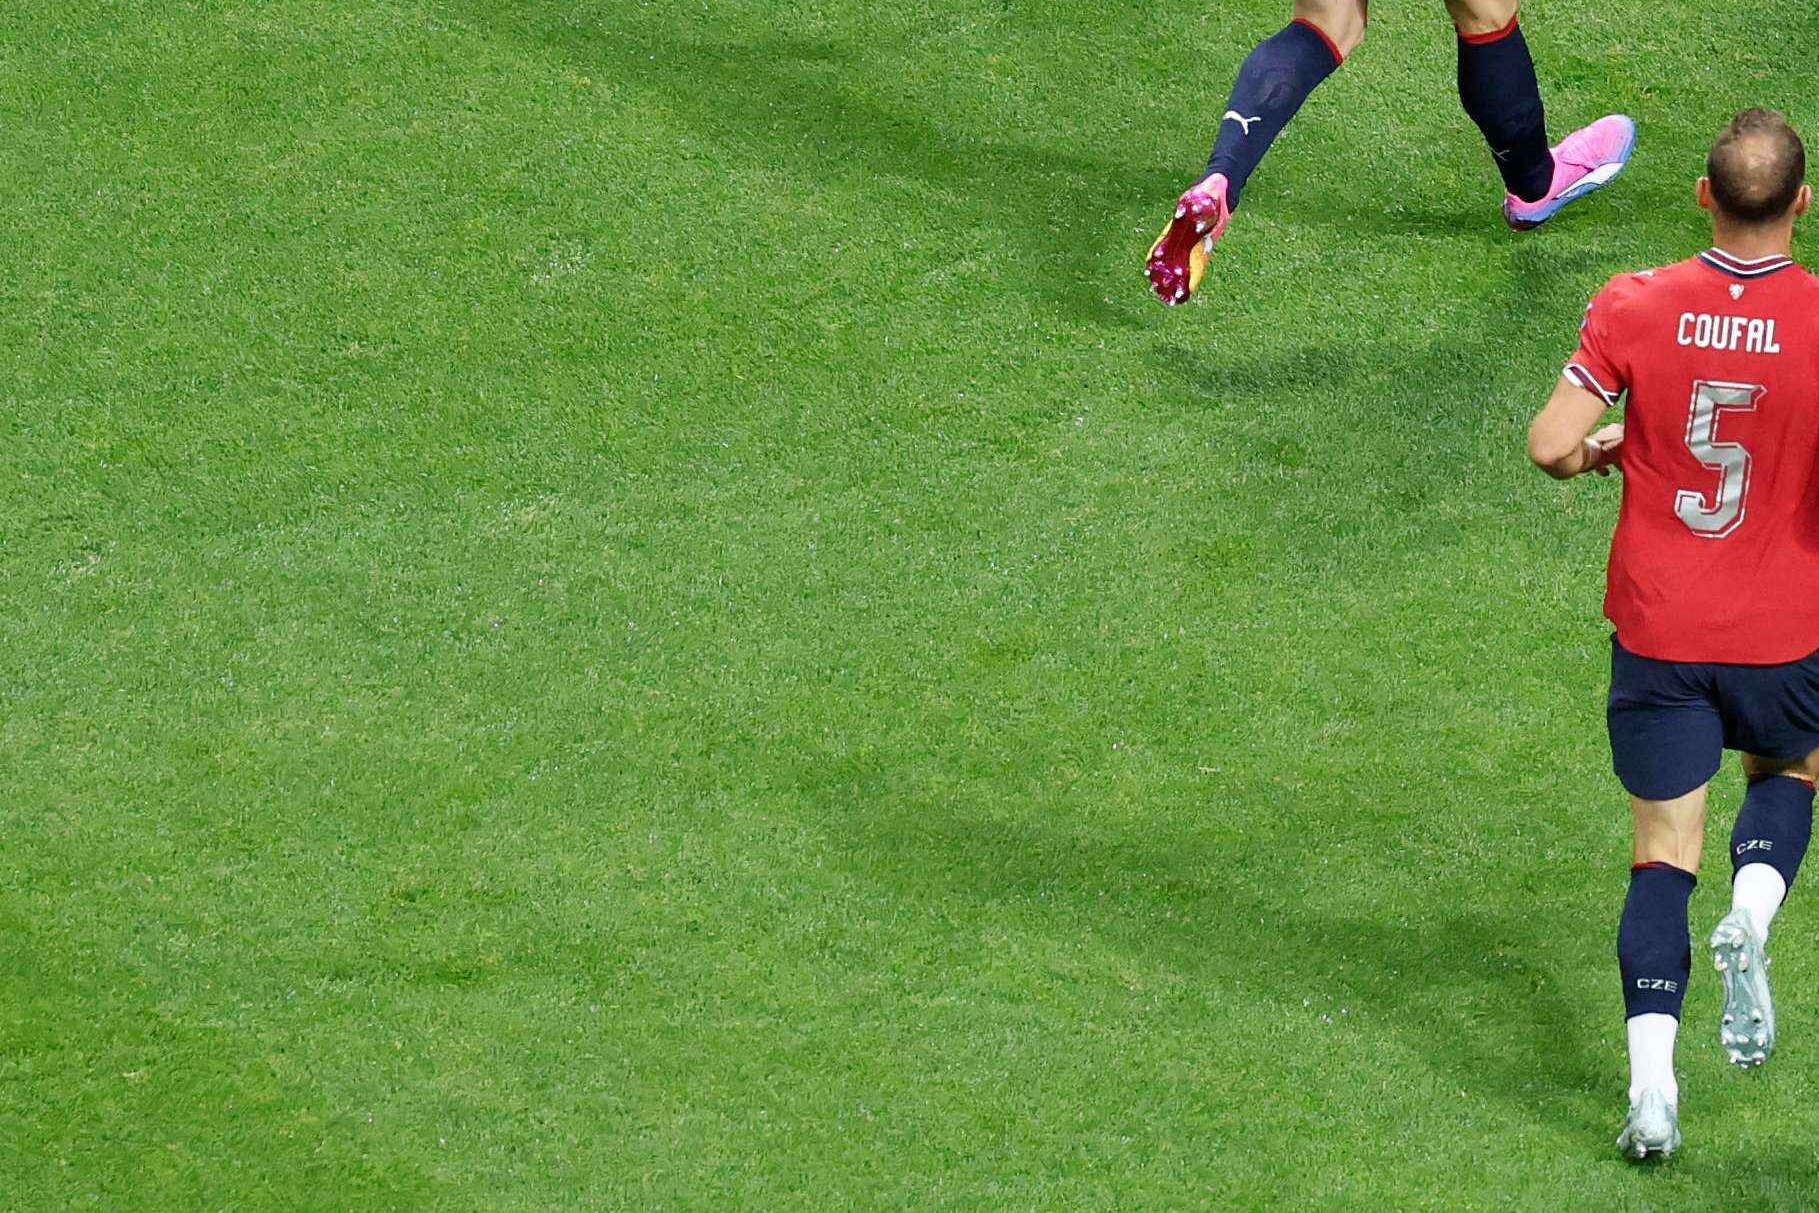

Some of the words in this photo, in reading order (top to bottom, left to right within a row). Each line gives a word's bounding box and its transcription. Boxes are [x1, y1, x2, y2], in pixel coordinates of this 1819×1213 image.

[1677, 312, 1780, 354] COUFAL
[1674, 379, 1768, 539] 5
[1736, 840, 1774, 855] CZE
[1636, 977, 1679, 993] CZE
